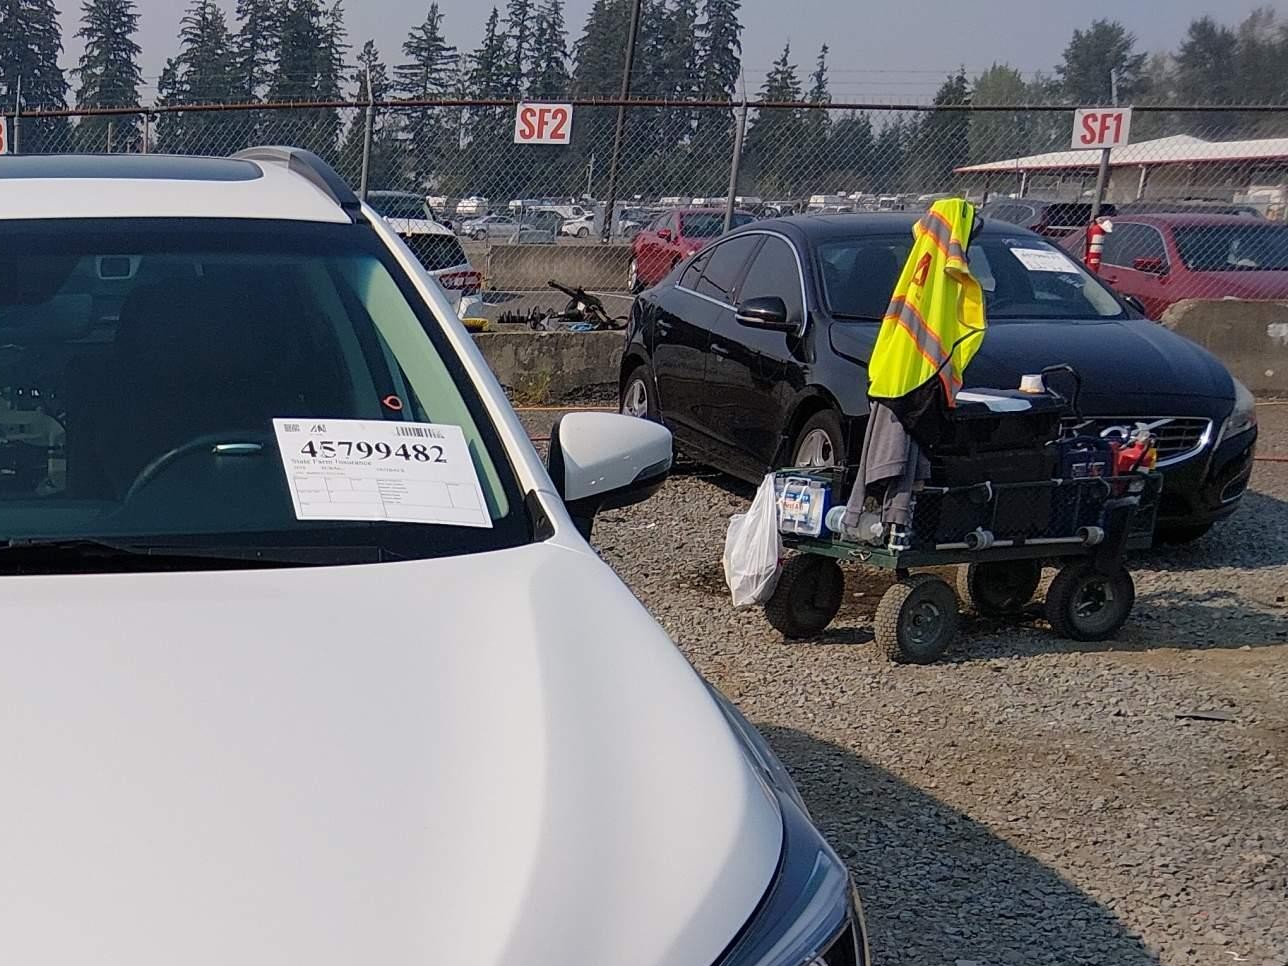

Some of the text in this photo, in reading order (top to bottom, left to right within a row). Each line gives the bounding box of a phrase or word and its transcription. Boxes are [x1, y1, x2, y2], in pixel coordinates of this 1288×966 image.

[519, 107, 566, 140] SF2
[1080, 112, 1123, 145] SF1
[300, 440, 448, 464] 45799482
